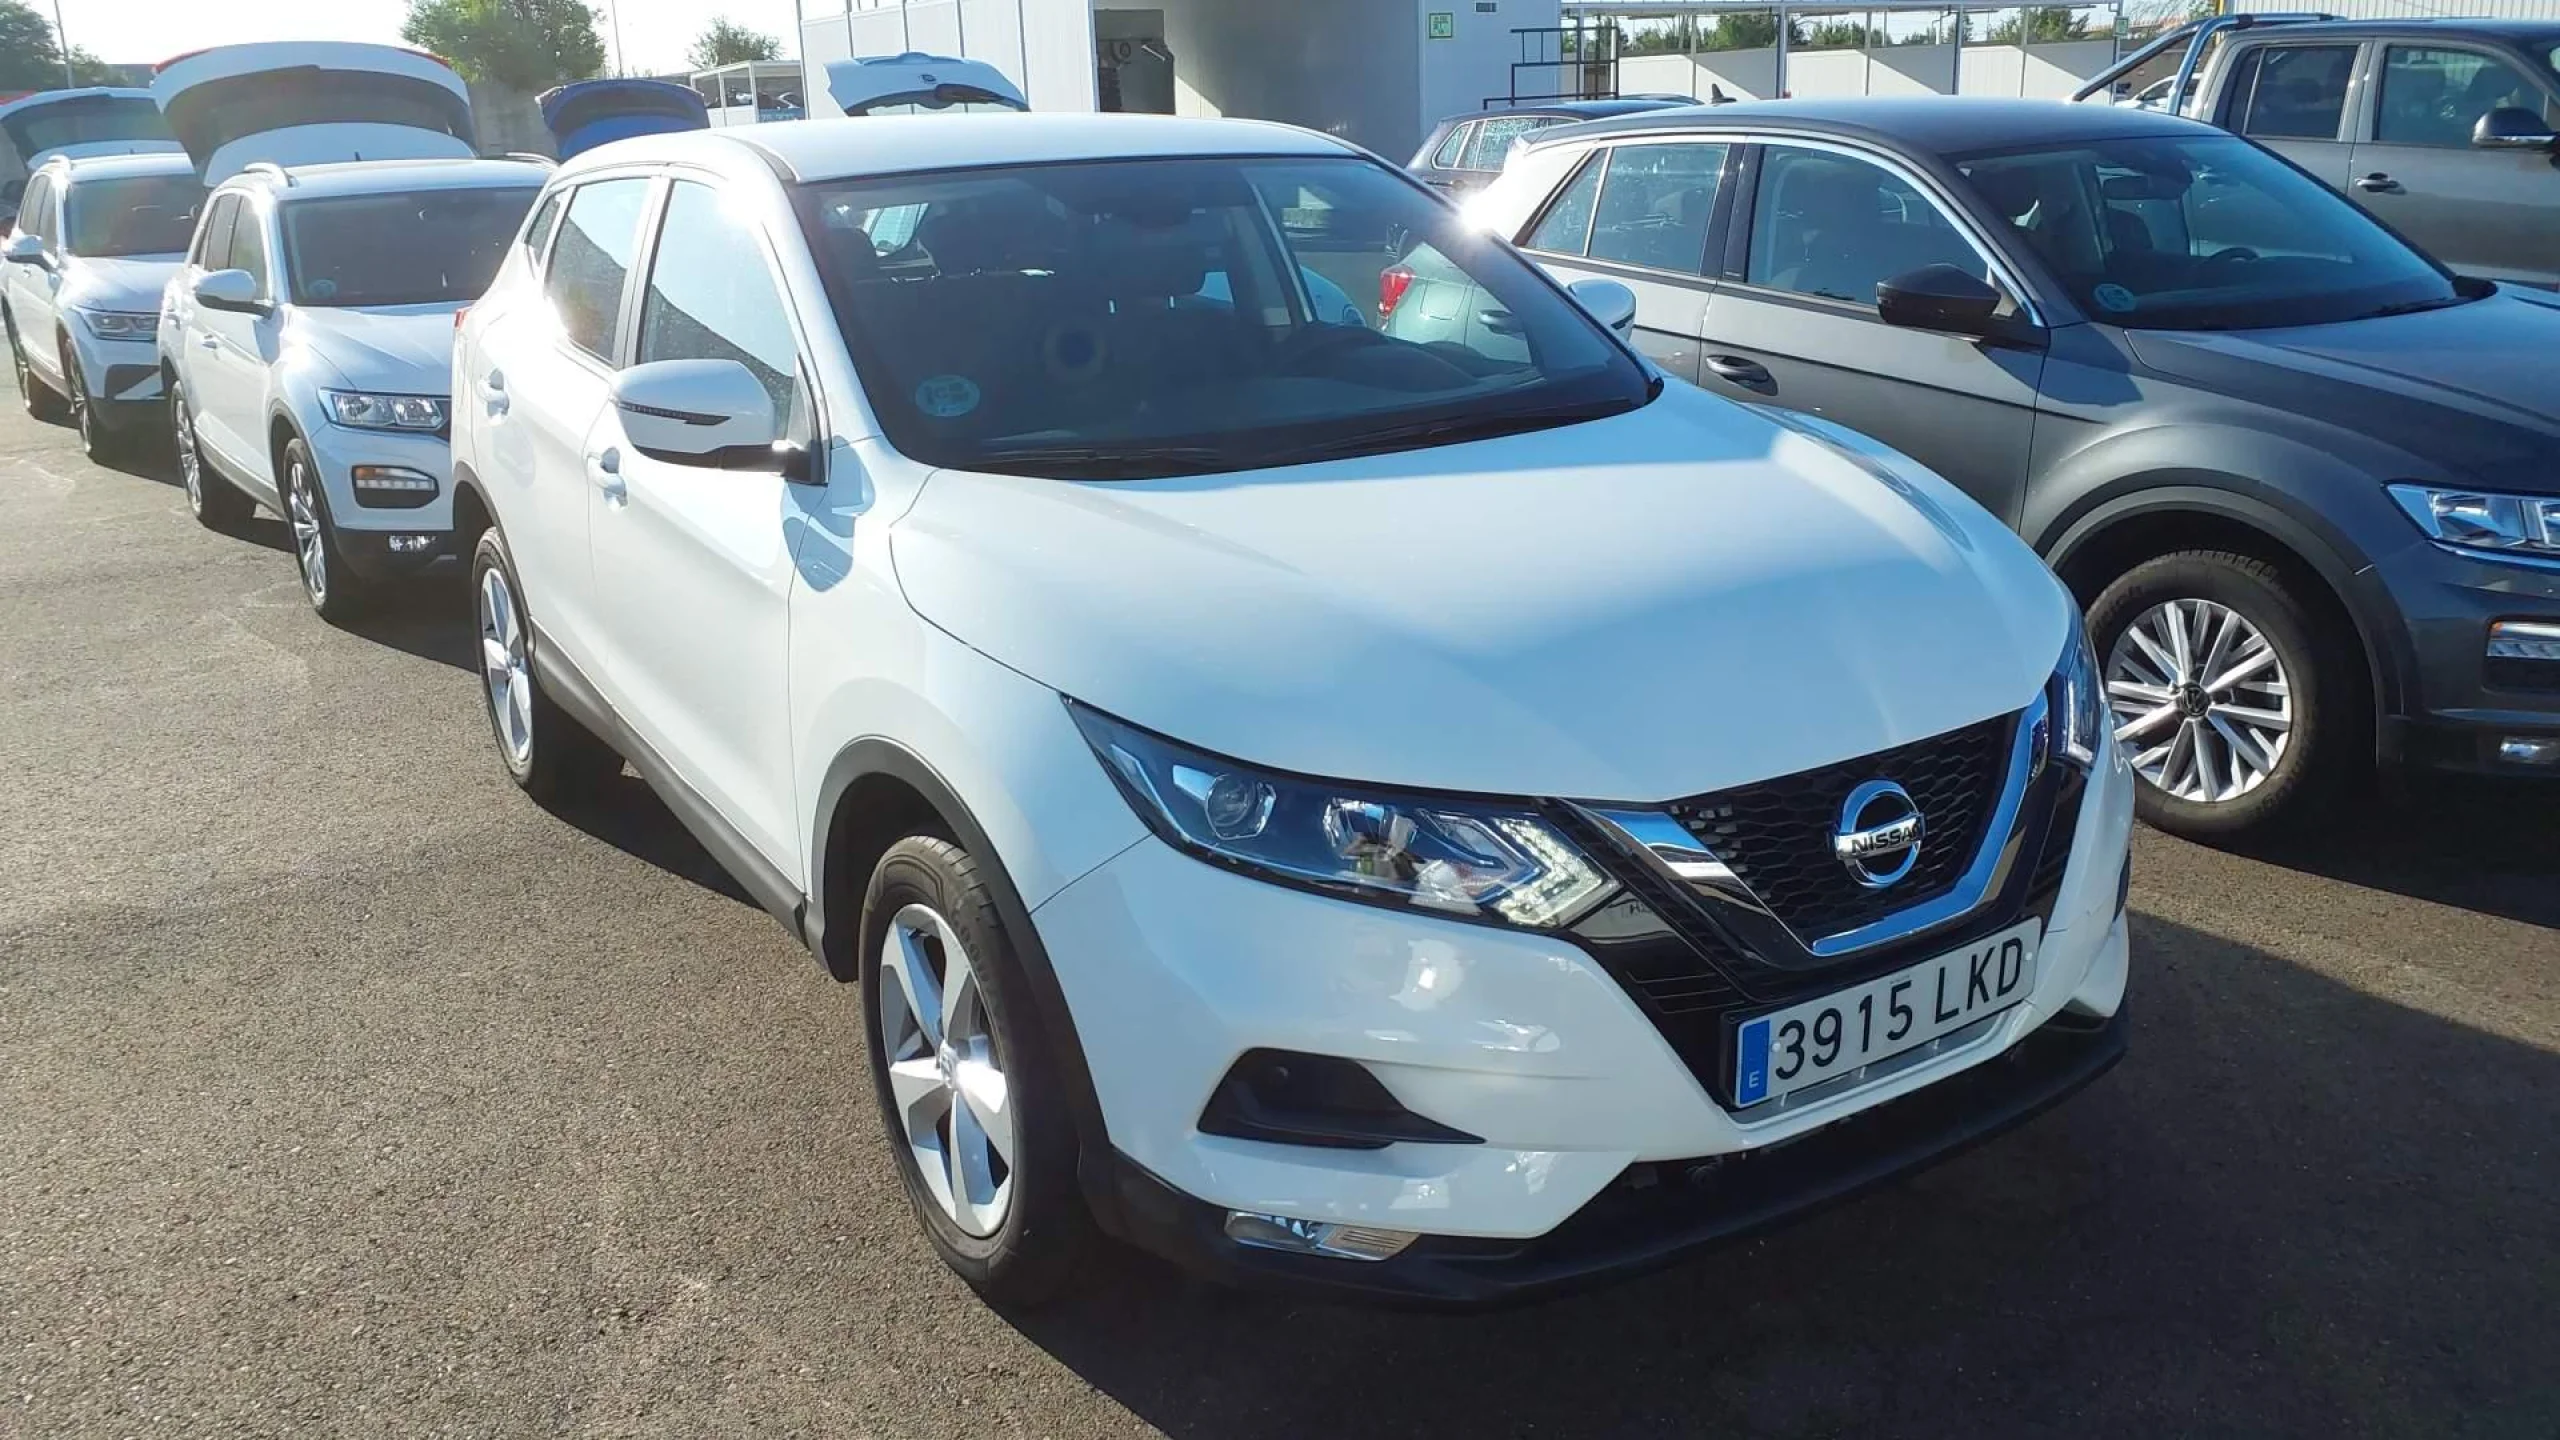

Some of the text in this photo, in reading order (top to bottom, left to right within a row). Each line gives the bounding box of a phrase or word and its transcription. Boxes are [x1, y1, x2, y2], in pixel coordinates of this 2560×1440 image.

[1775, 937, 2023, 1080] 3915 LKD
[1749, 1070, 1760, 1088] E
